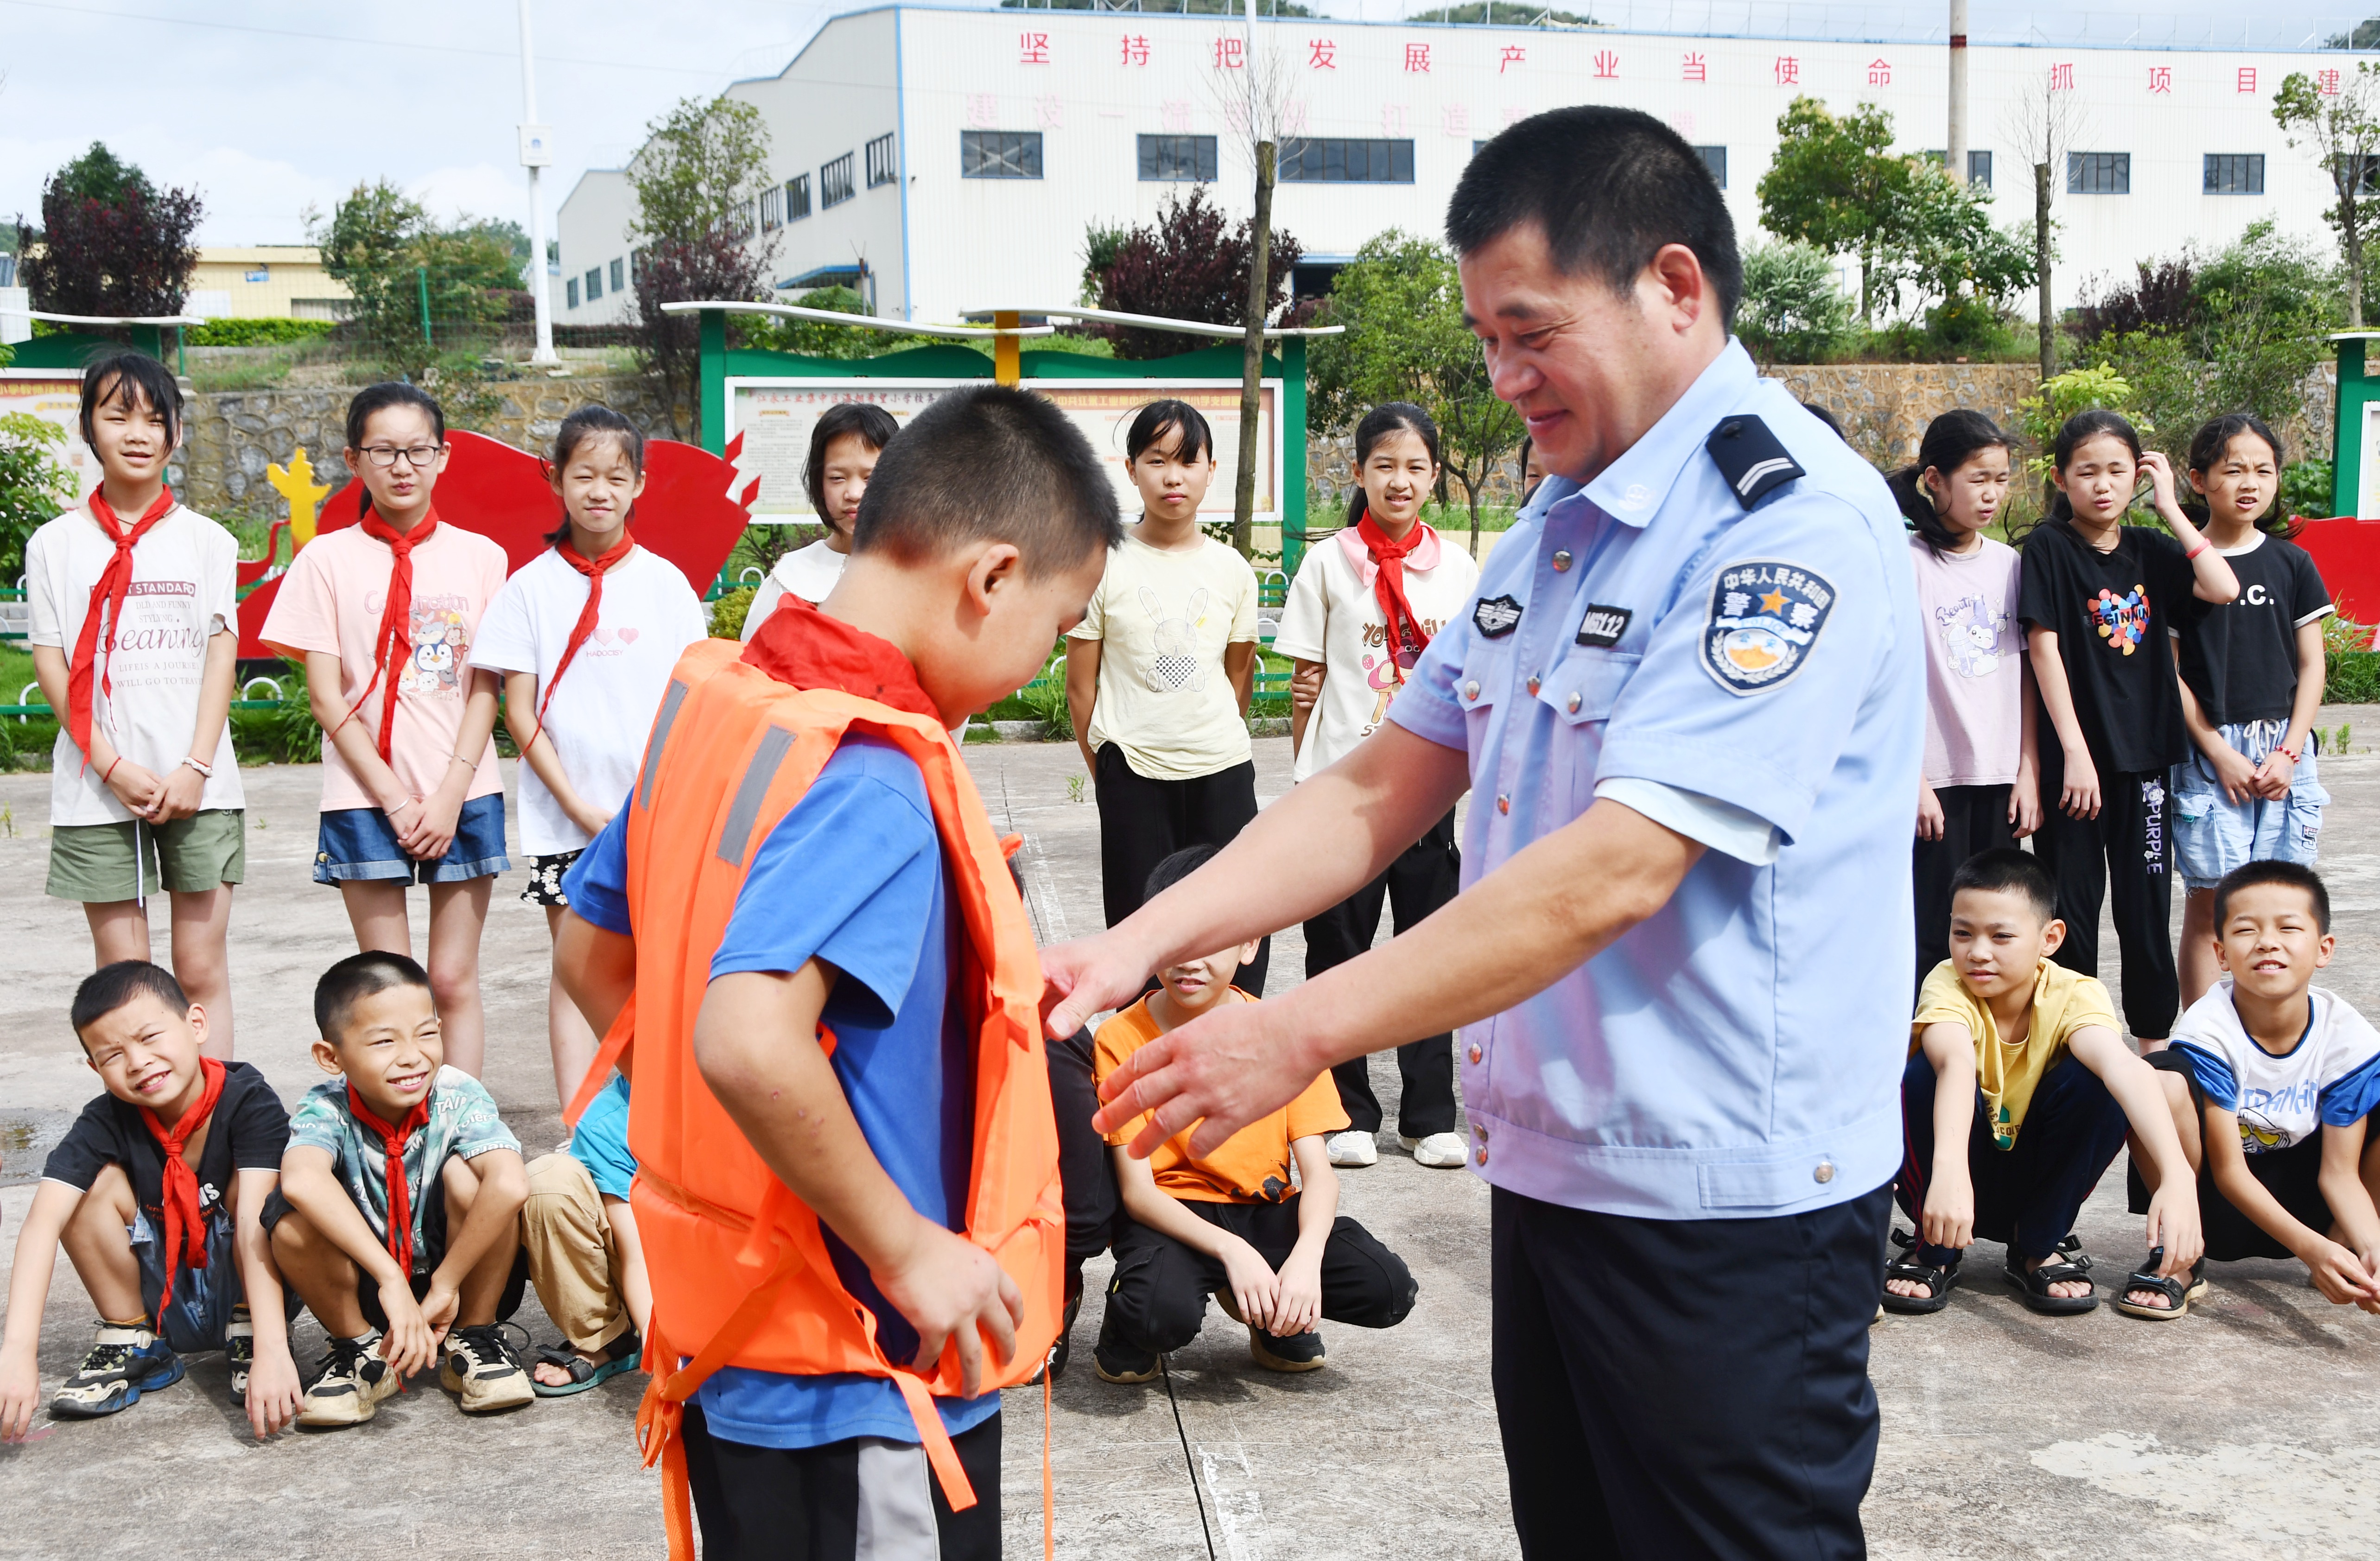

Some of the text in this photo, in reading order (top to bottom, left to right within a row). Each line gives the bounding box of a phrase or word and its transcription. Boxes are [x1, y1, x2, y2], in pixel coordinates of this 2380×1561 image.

[136, 583, 195, 595] STANDARD
[1724, 566, 1831, 610] 中华人民共和国
[168, 601, 192, 609] FUNNY
[1741, 617, 1787, 634] POLICE
[586, 649, 623, 658] HADOCISY
[117, 679, 143, 688] WILL
[2145, 802, 2163, 875] PURPLE
